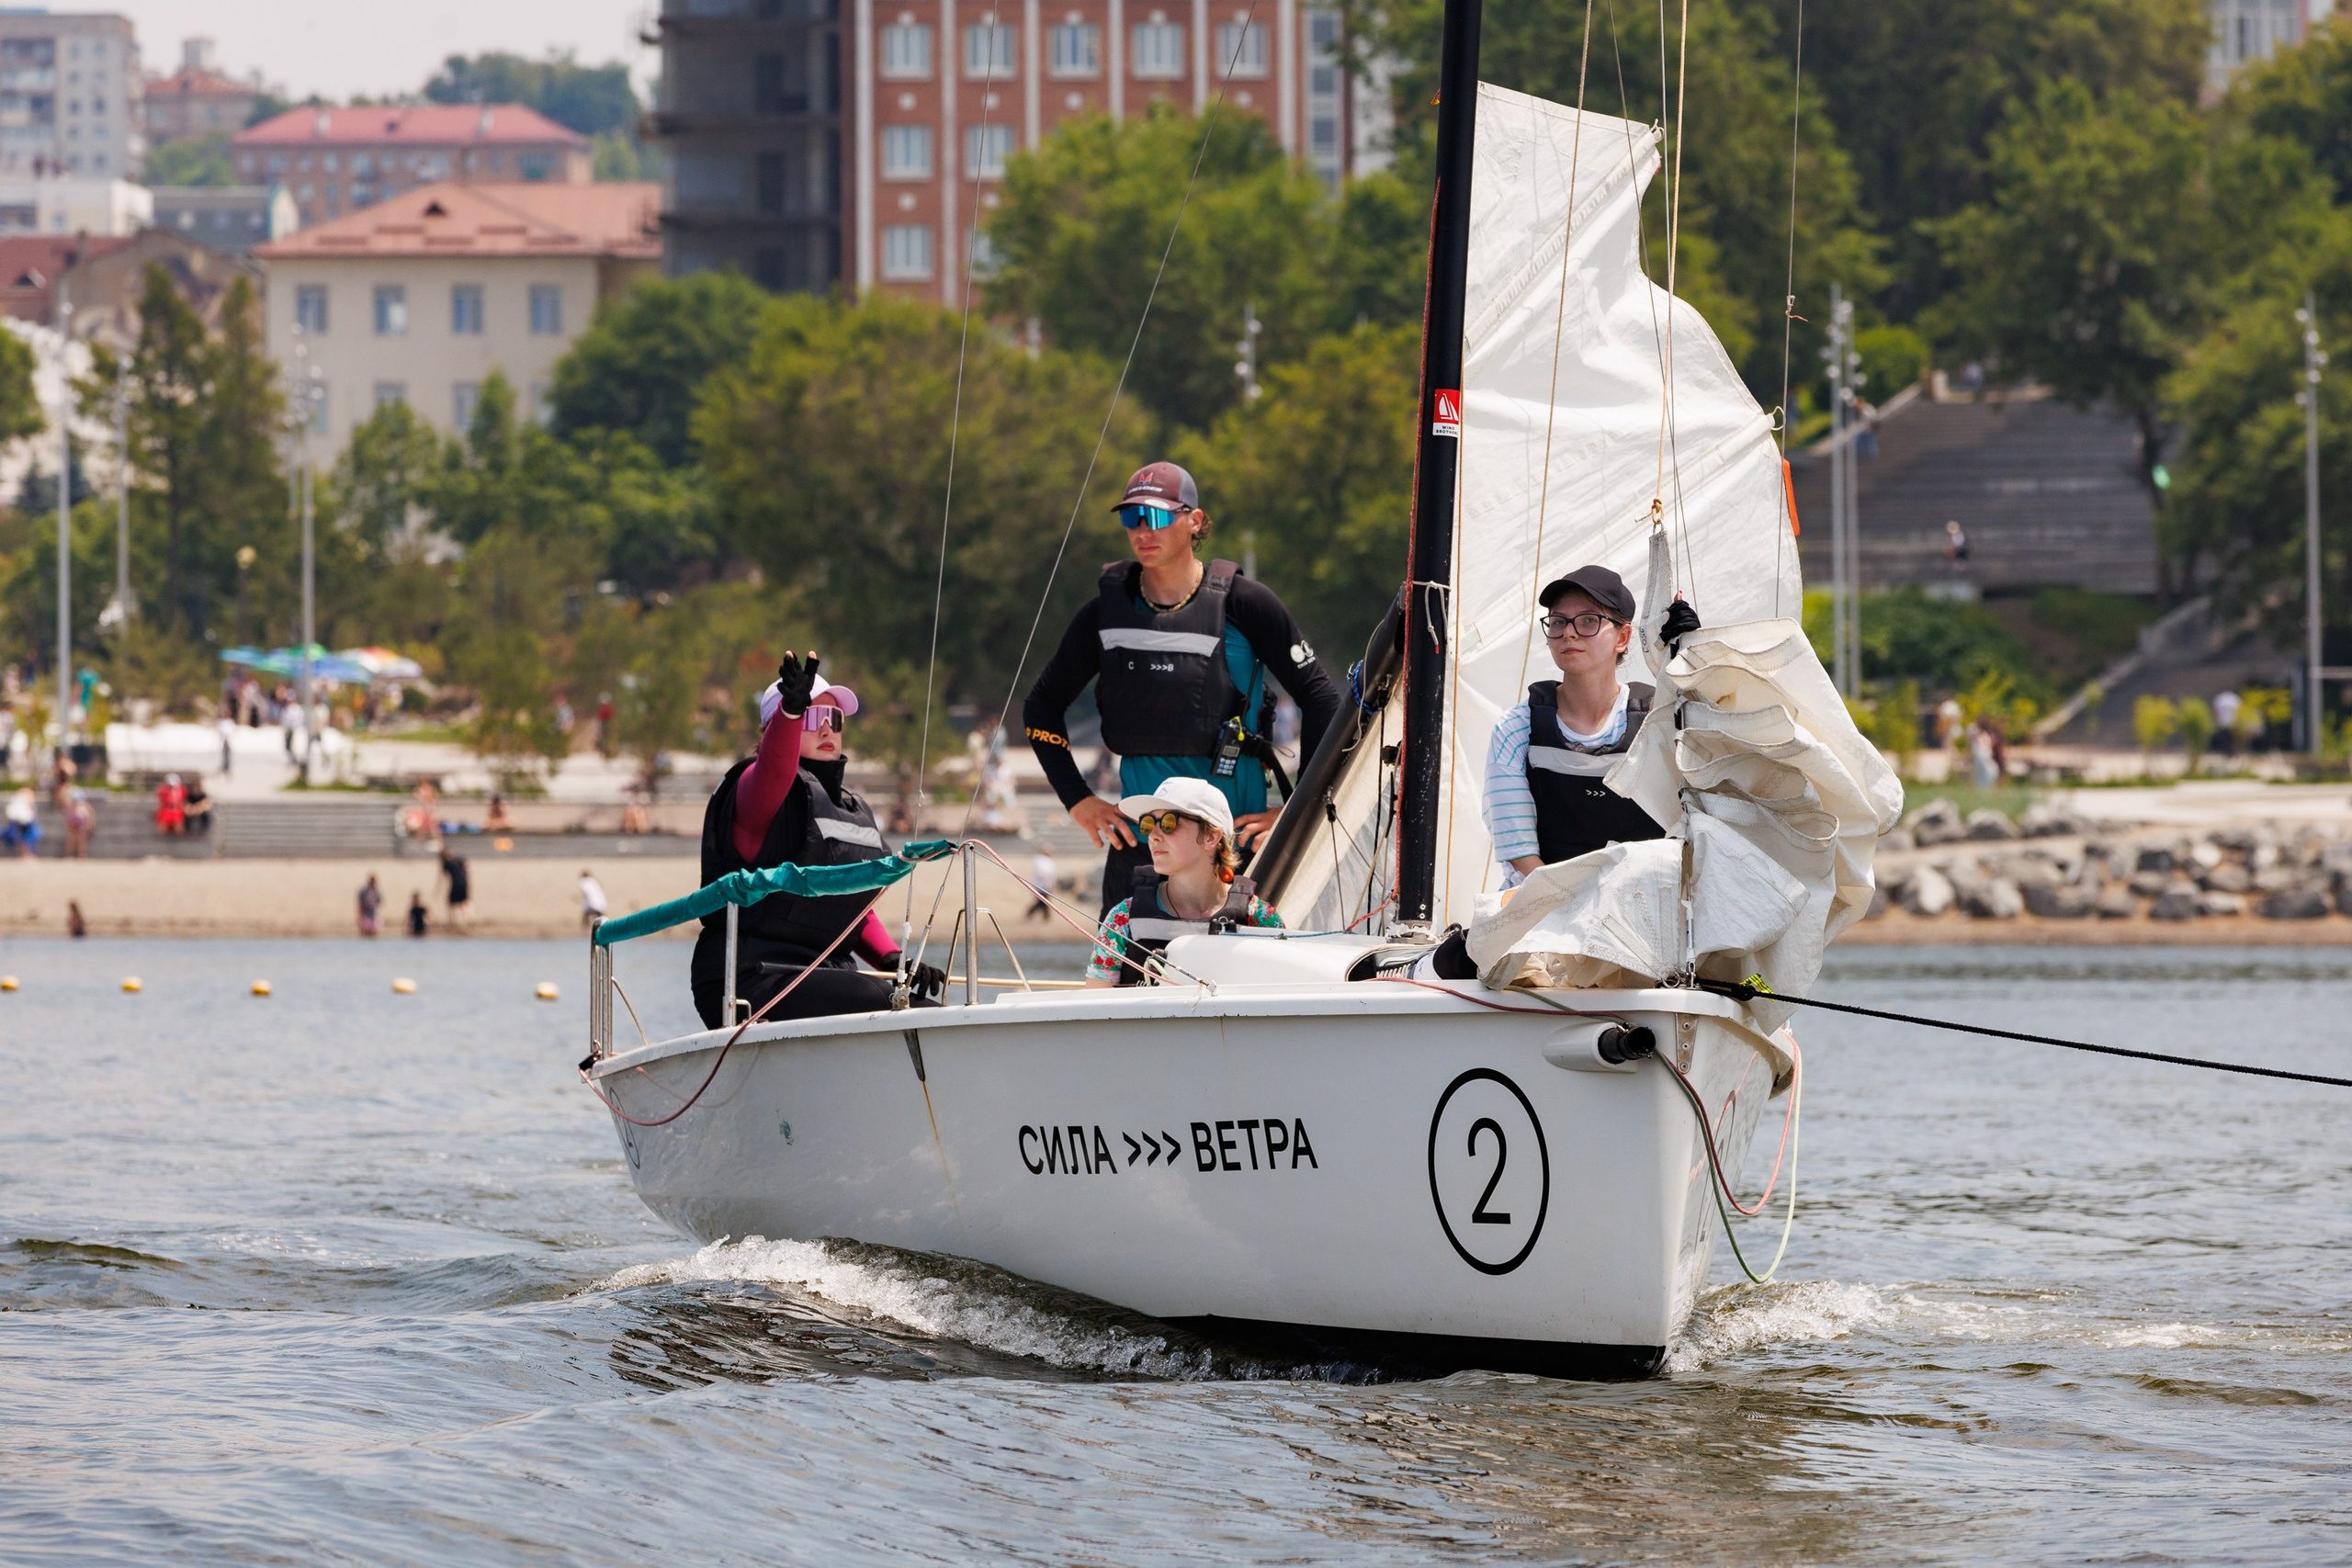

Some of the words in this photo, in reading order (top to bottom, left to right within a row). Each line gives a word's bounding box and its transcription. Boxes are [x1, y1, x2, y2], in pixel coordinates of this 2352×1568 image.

[1018, 1124, 1118, 1175] СИЛА
[1190, 1117, 1319, 1172] ВЕТРА
[1467, 1117, 1511, 1224] 2
